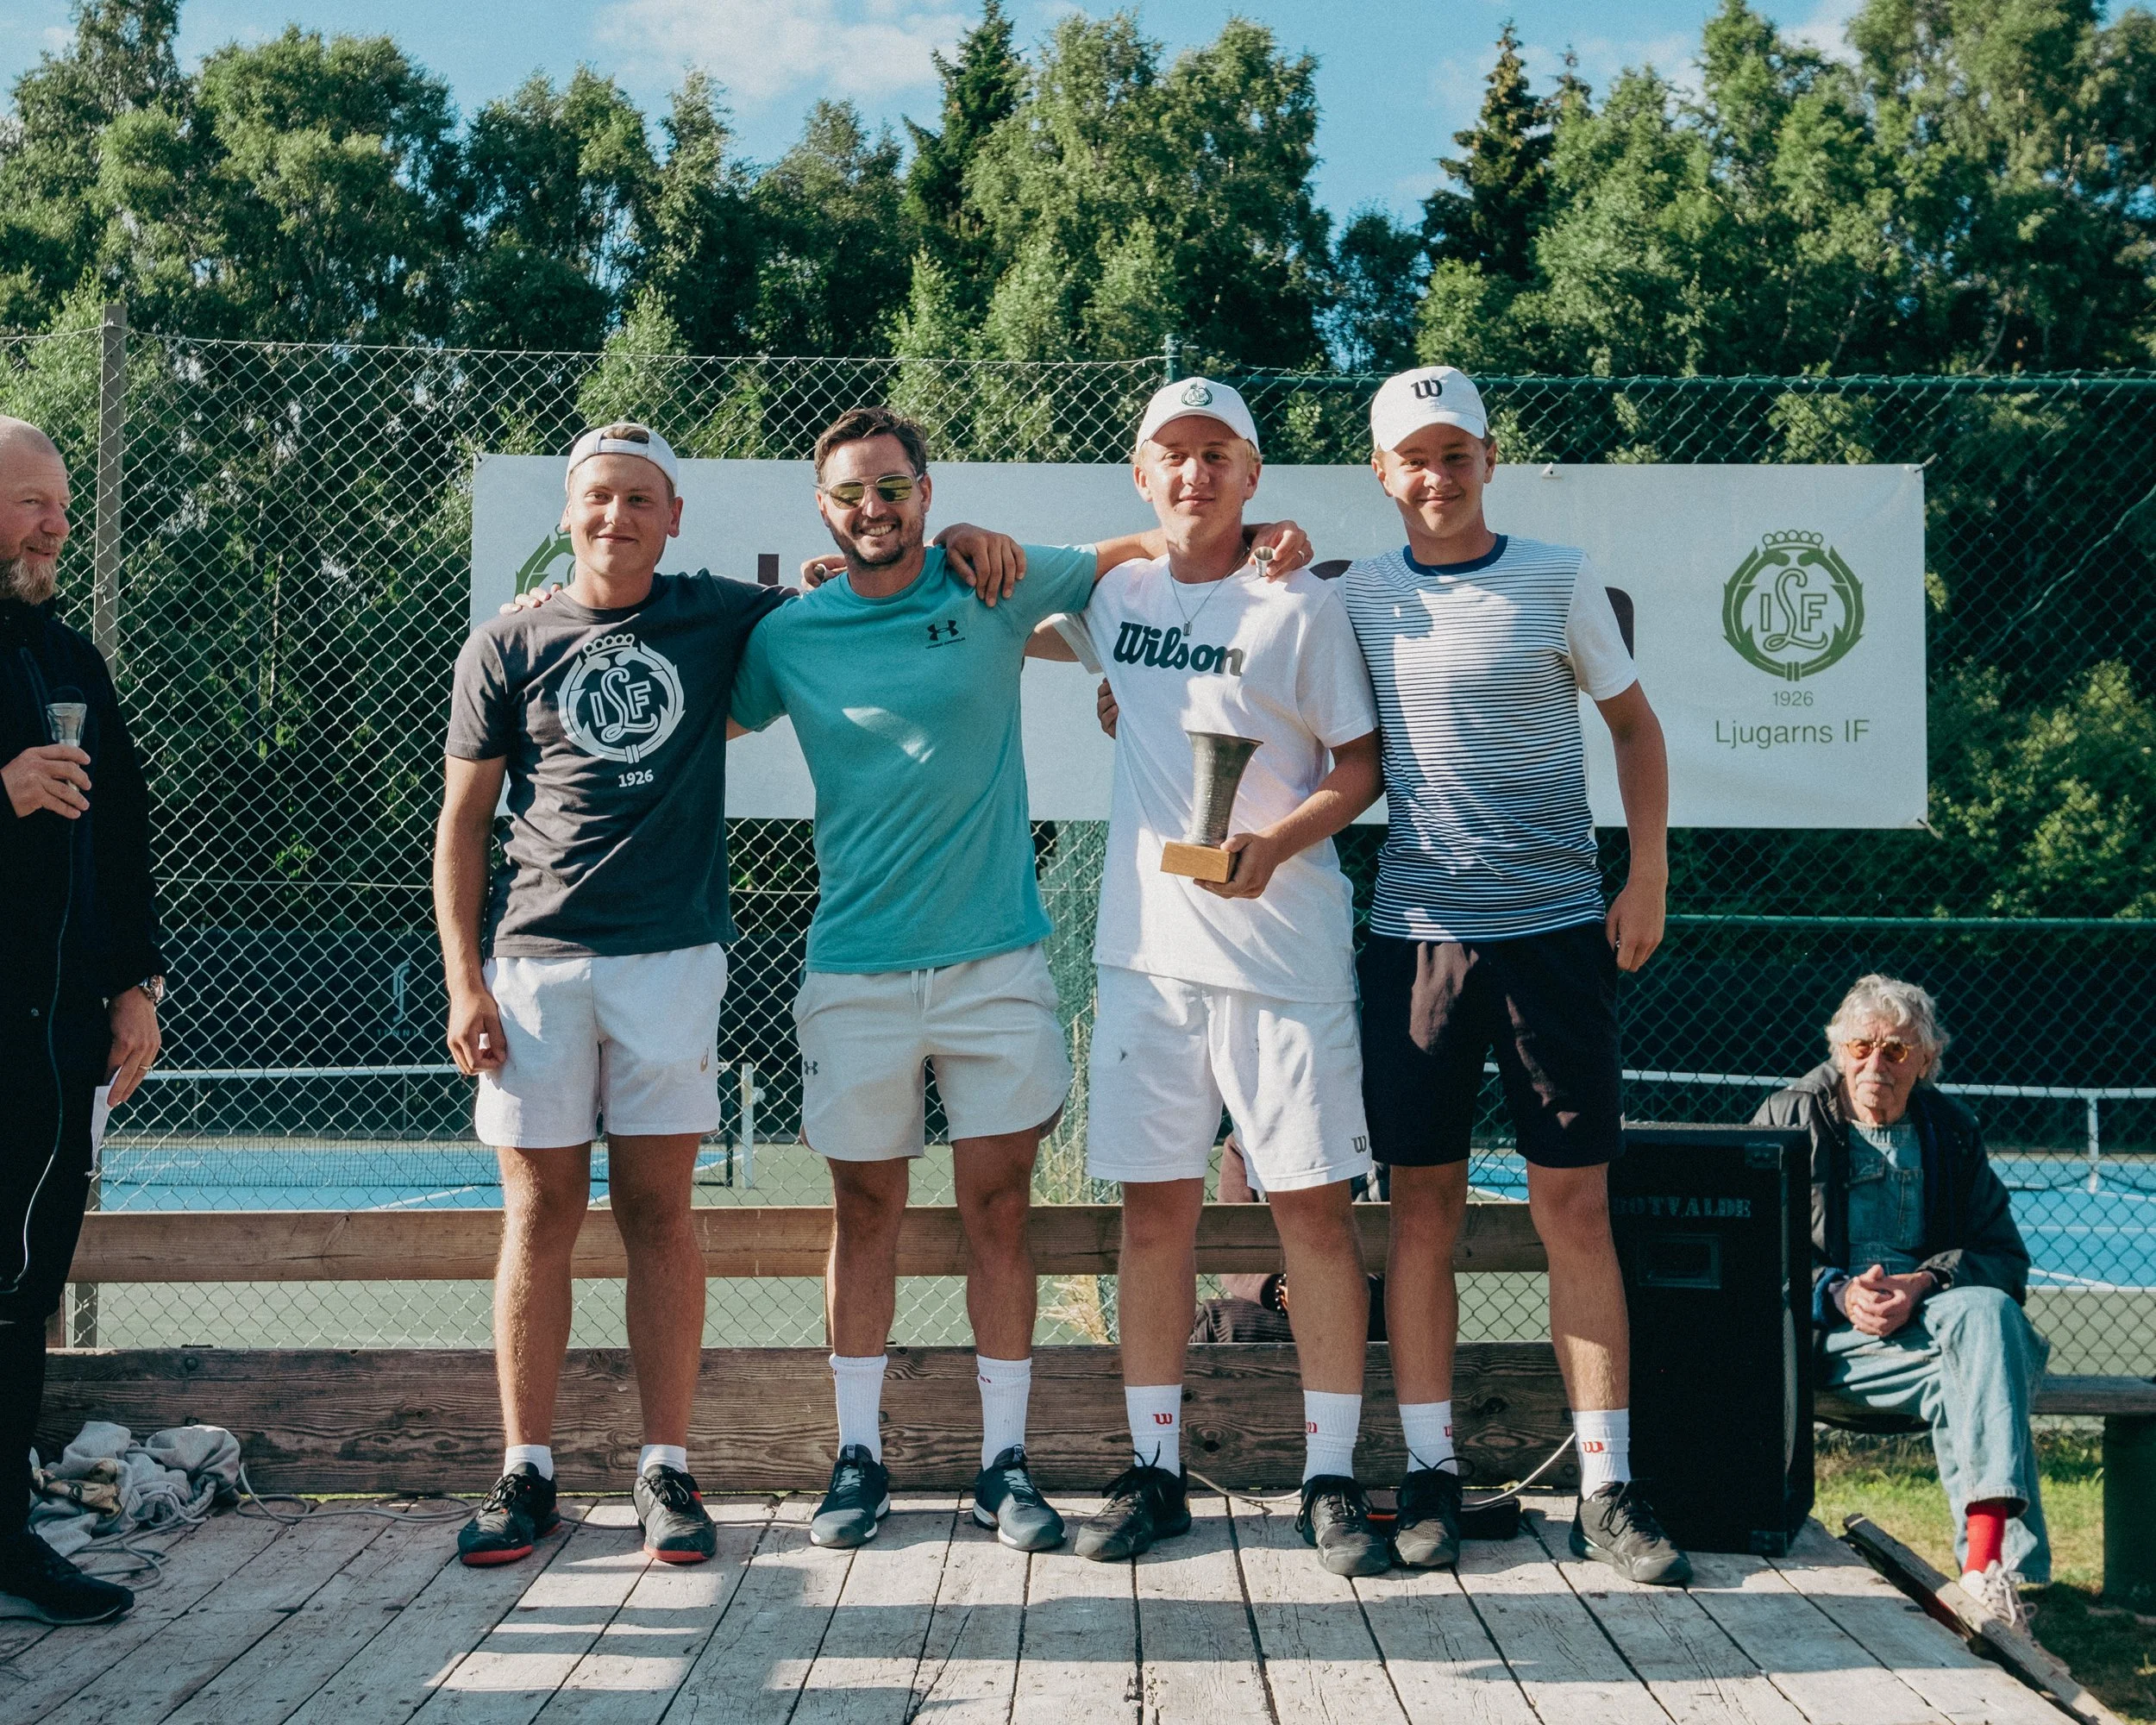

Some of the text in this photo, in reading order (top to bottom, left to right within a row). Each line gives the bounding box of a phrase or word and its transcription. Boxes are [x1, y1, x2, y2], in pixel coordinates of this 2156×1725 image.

[1113, 621, 1244, 676] Wilson
[1772, 691, 1814, 706] 1926
[1715, 719, 1870, 749] Ljugarns IF
[618, 769, 654, 787] 1926
